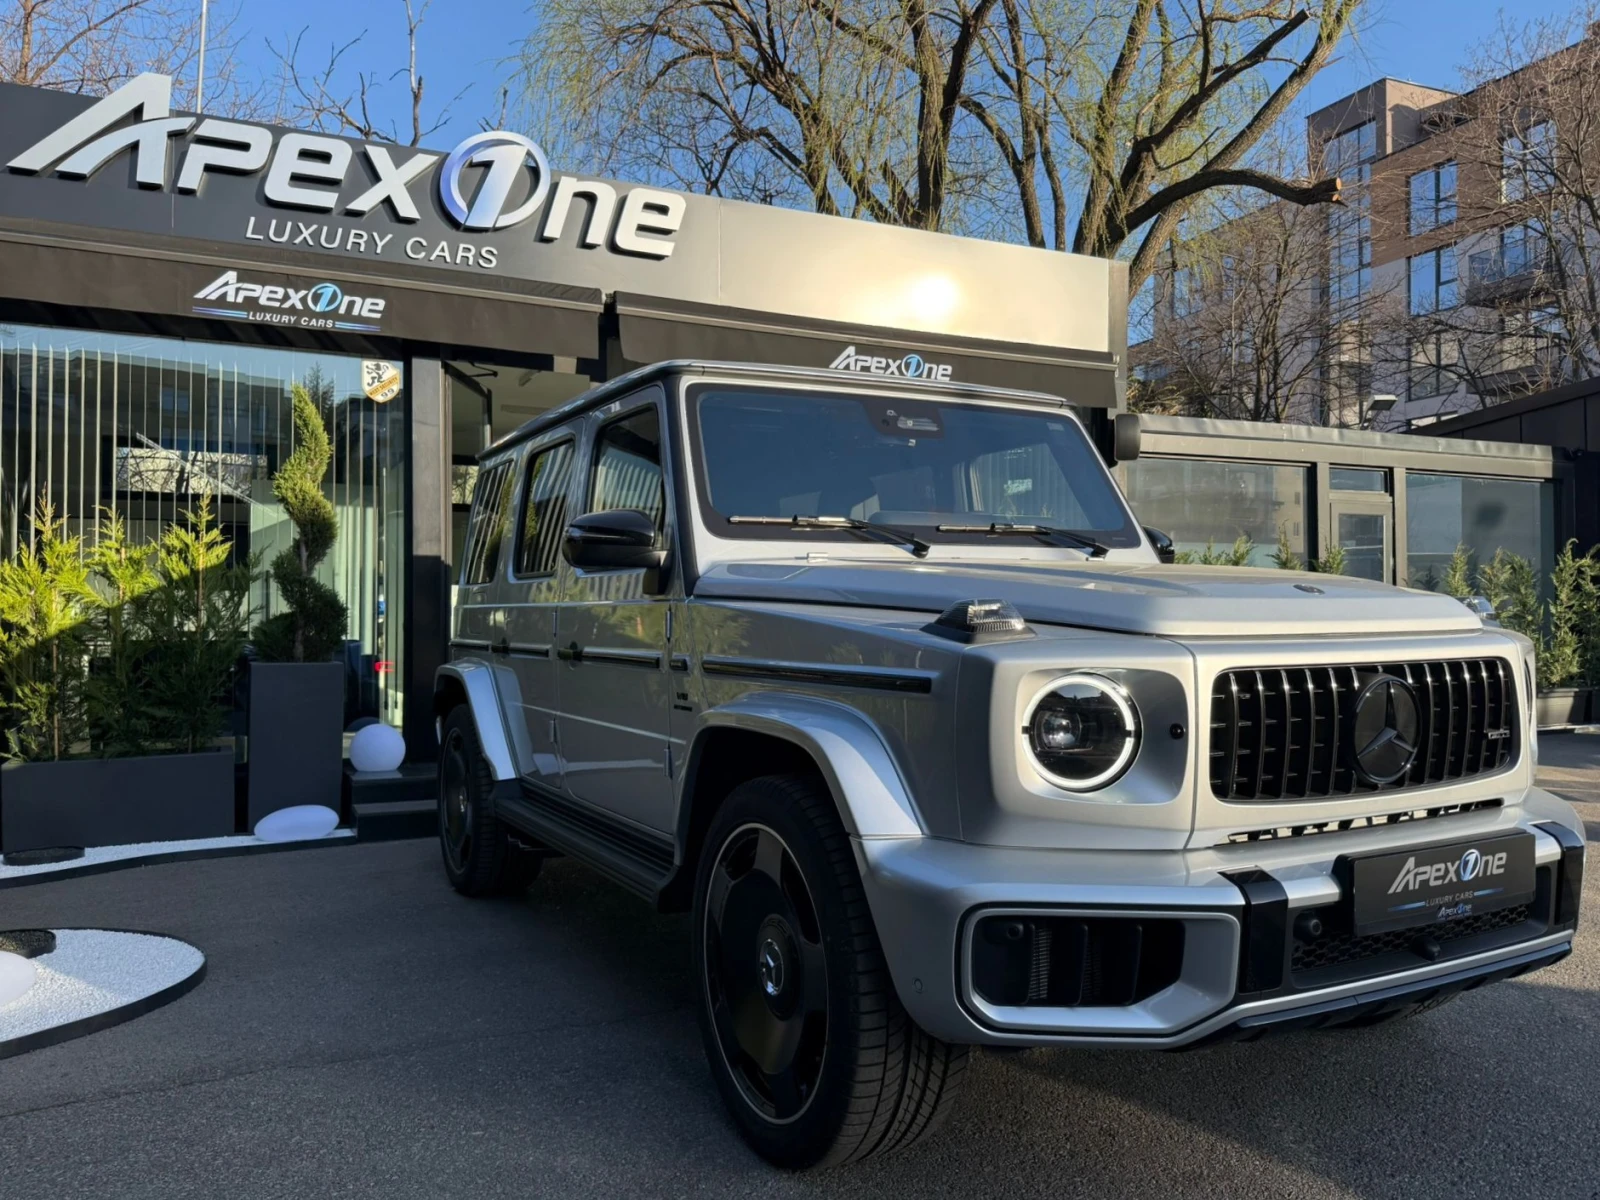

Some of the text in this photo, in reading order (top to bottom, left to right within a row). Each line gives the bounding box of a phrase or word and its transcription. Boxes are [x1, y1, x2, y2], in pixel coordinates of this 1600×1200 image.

[245, 217, 499, 268] LUXURY CARS
[248, 311, 333, 328] LUXURY CARS
[1426, 890, 1473, 907] LUXURY CARS
